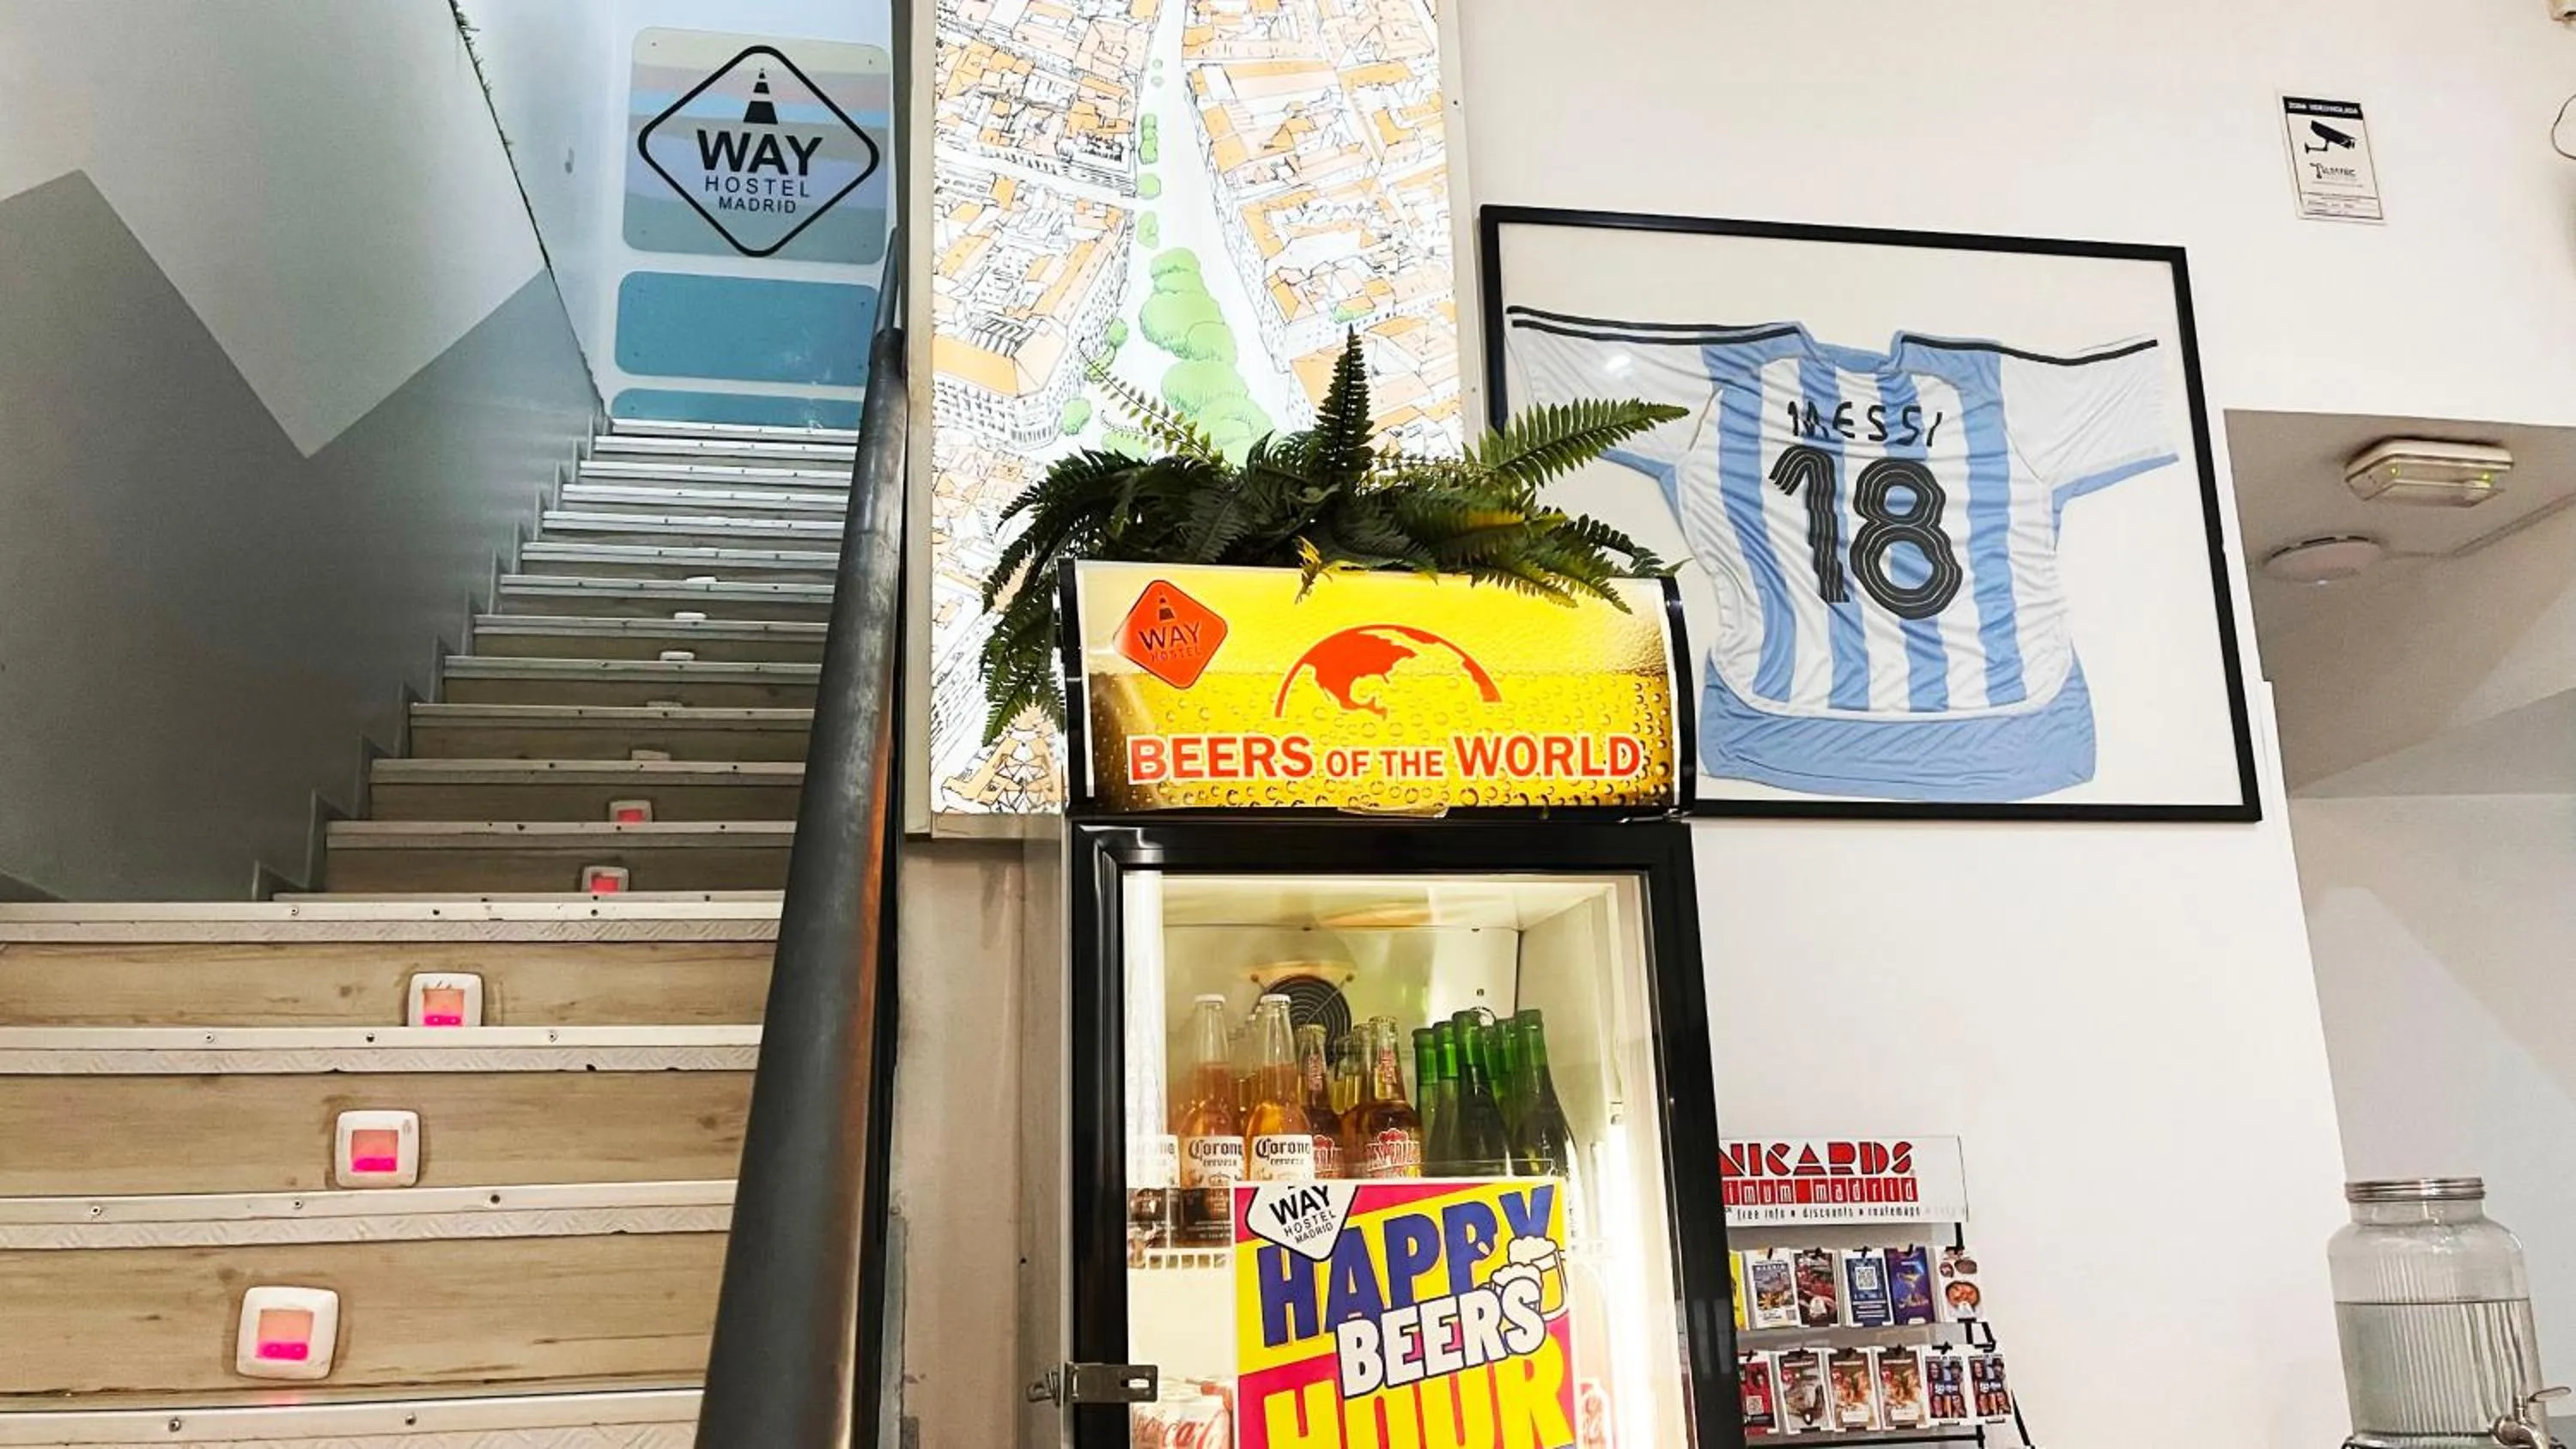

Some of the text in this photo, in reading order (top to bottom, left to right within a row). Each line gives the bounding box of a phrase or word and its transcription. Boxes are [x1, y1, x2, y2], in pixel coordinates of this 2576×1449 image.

[696, 129, 823, 177] WAY
[705, 176, 810, 198] HOSTEL
[718, 196, 797, 214] MADRID
[1787, 401, 1943, 447] MESSI
[1769, 444, 1964, 621] 18
[1139, 621, 1200, 651] WAY
[1128, 735, 1642, 785] BEERS OF THE WORLD
[1269, 1185, 1331, 1226] WAY
[1814, 1179, 1916, 1203] madrid
[1284, 1210, 1338, 1237] HOSTEL
[1738, 1207, 1759, 1221] free
[1765, 1208, 1785, 1221] info
[1803, 1206, 1853, 1219] discounts
[1295, 1222, 1334, 1244] MADRID
[1257, 1184, 1555, 1349] HAPPY
[1338, 1276, 1546, 1400] BEERS
